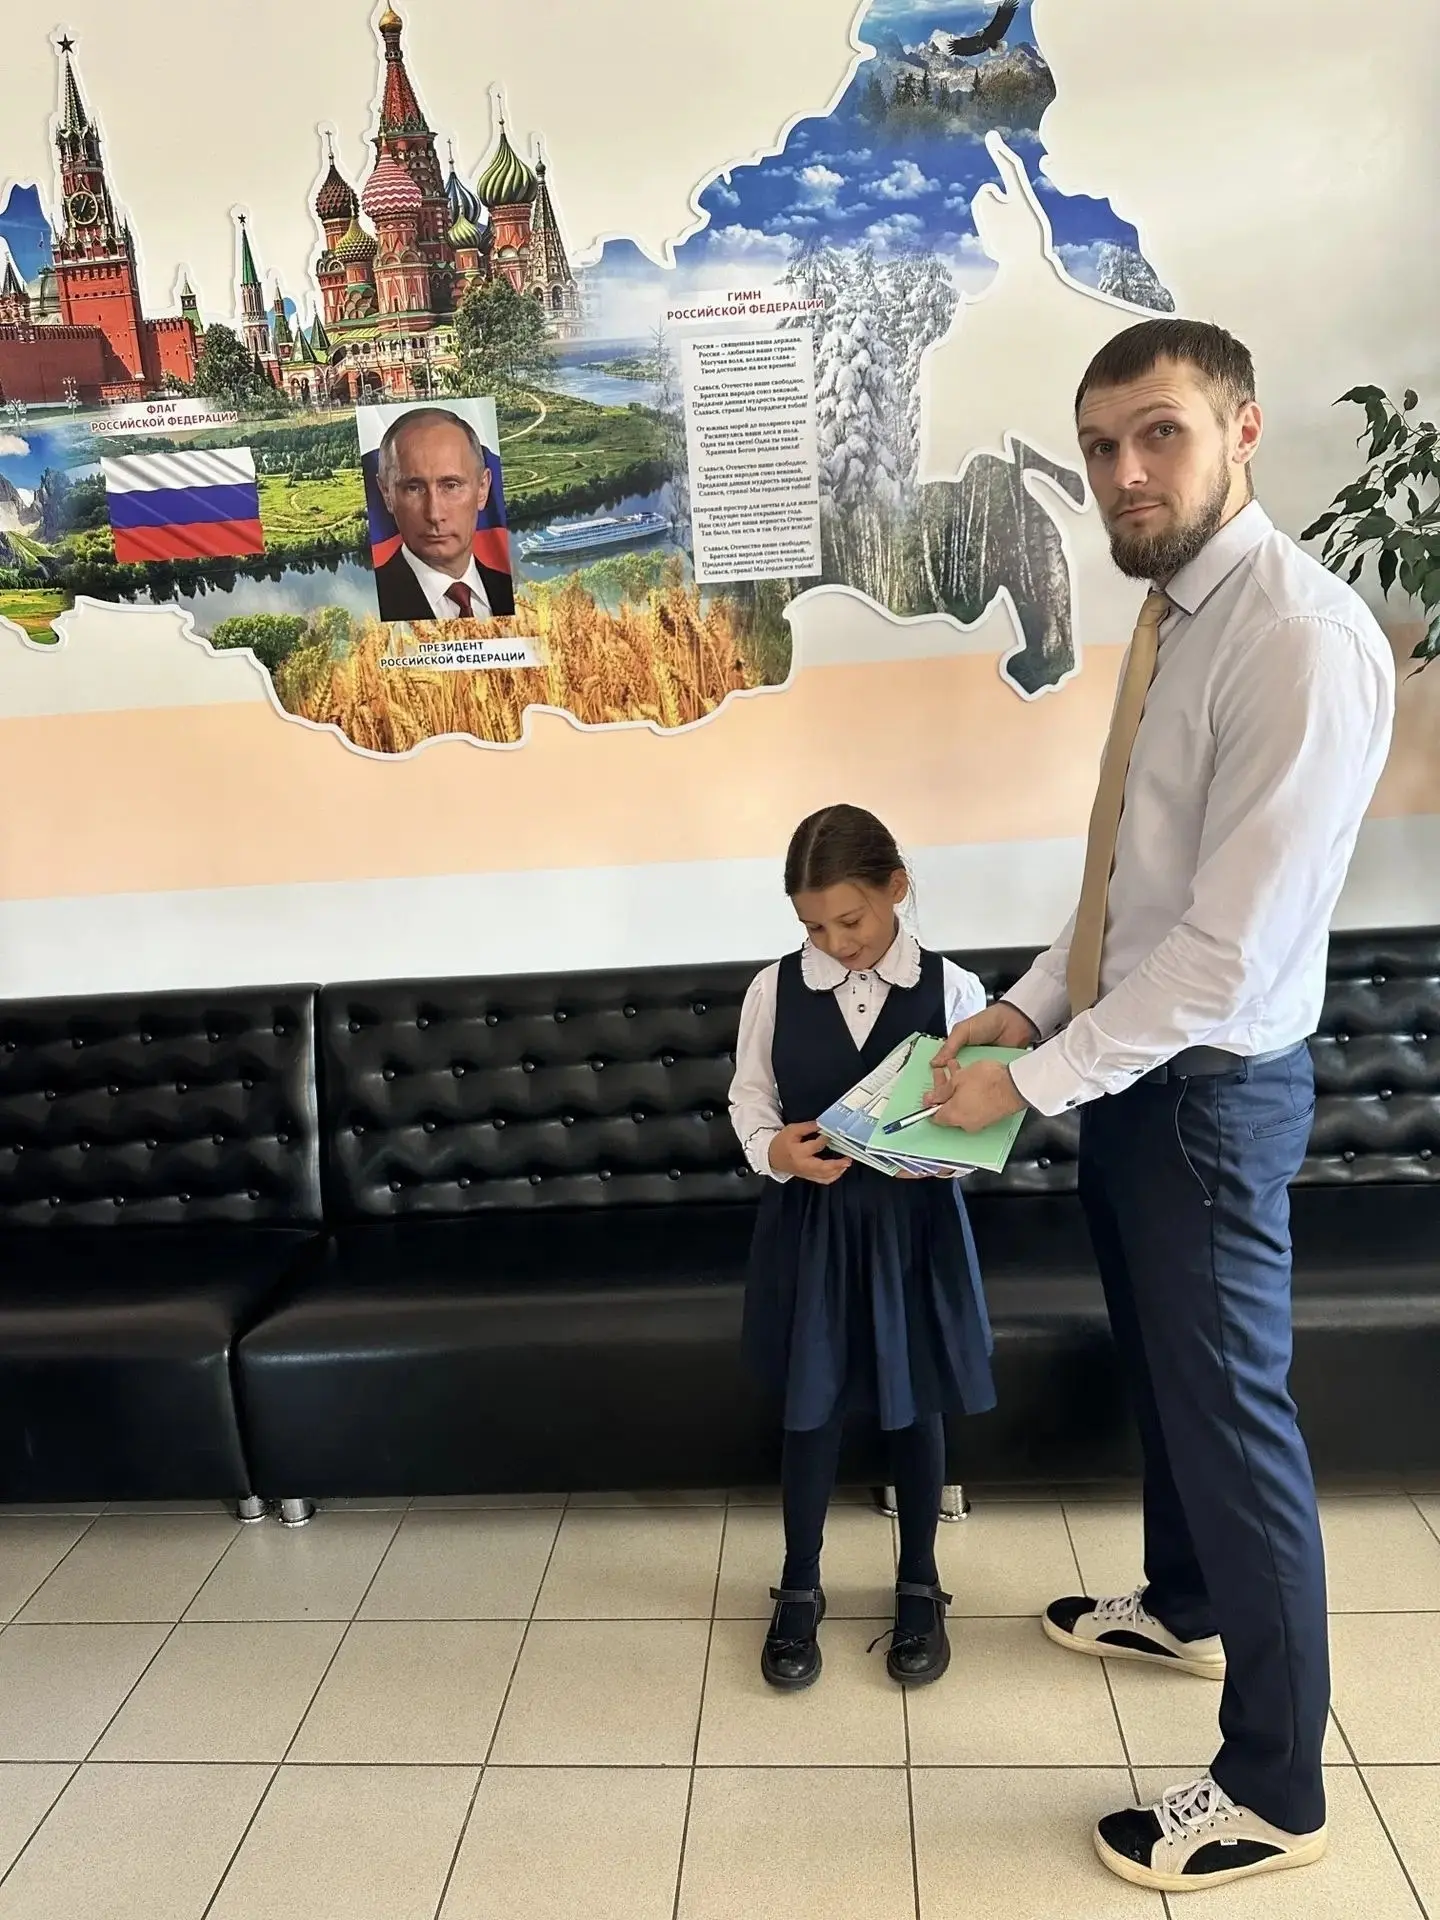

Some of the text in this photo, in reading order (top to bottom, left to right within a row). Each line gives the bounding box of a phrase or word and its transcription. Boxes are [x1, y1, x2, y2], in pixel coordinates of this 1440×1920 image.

[728, 290, 761, 301] ГИМН
[667, 299, 825, 320] РОССИЙСКОЙ ФЕДЕРАЦИИ
[146, 403, 177, 414] ФЛАГ
[91, 411, 238, 431] РОССИЙСКОЙ ФЕДЕРАЦИИ
[419, 641, 484, 653] ПРЕЗИДЕНТ
[380, 652, 526, 667] РОССИЙСКОЙ ФЕДЕРАЦИИ
